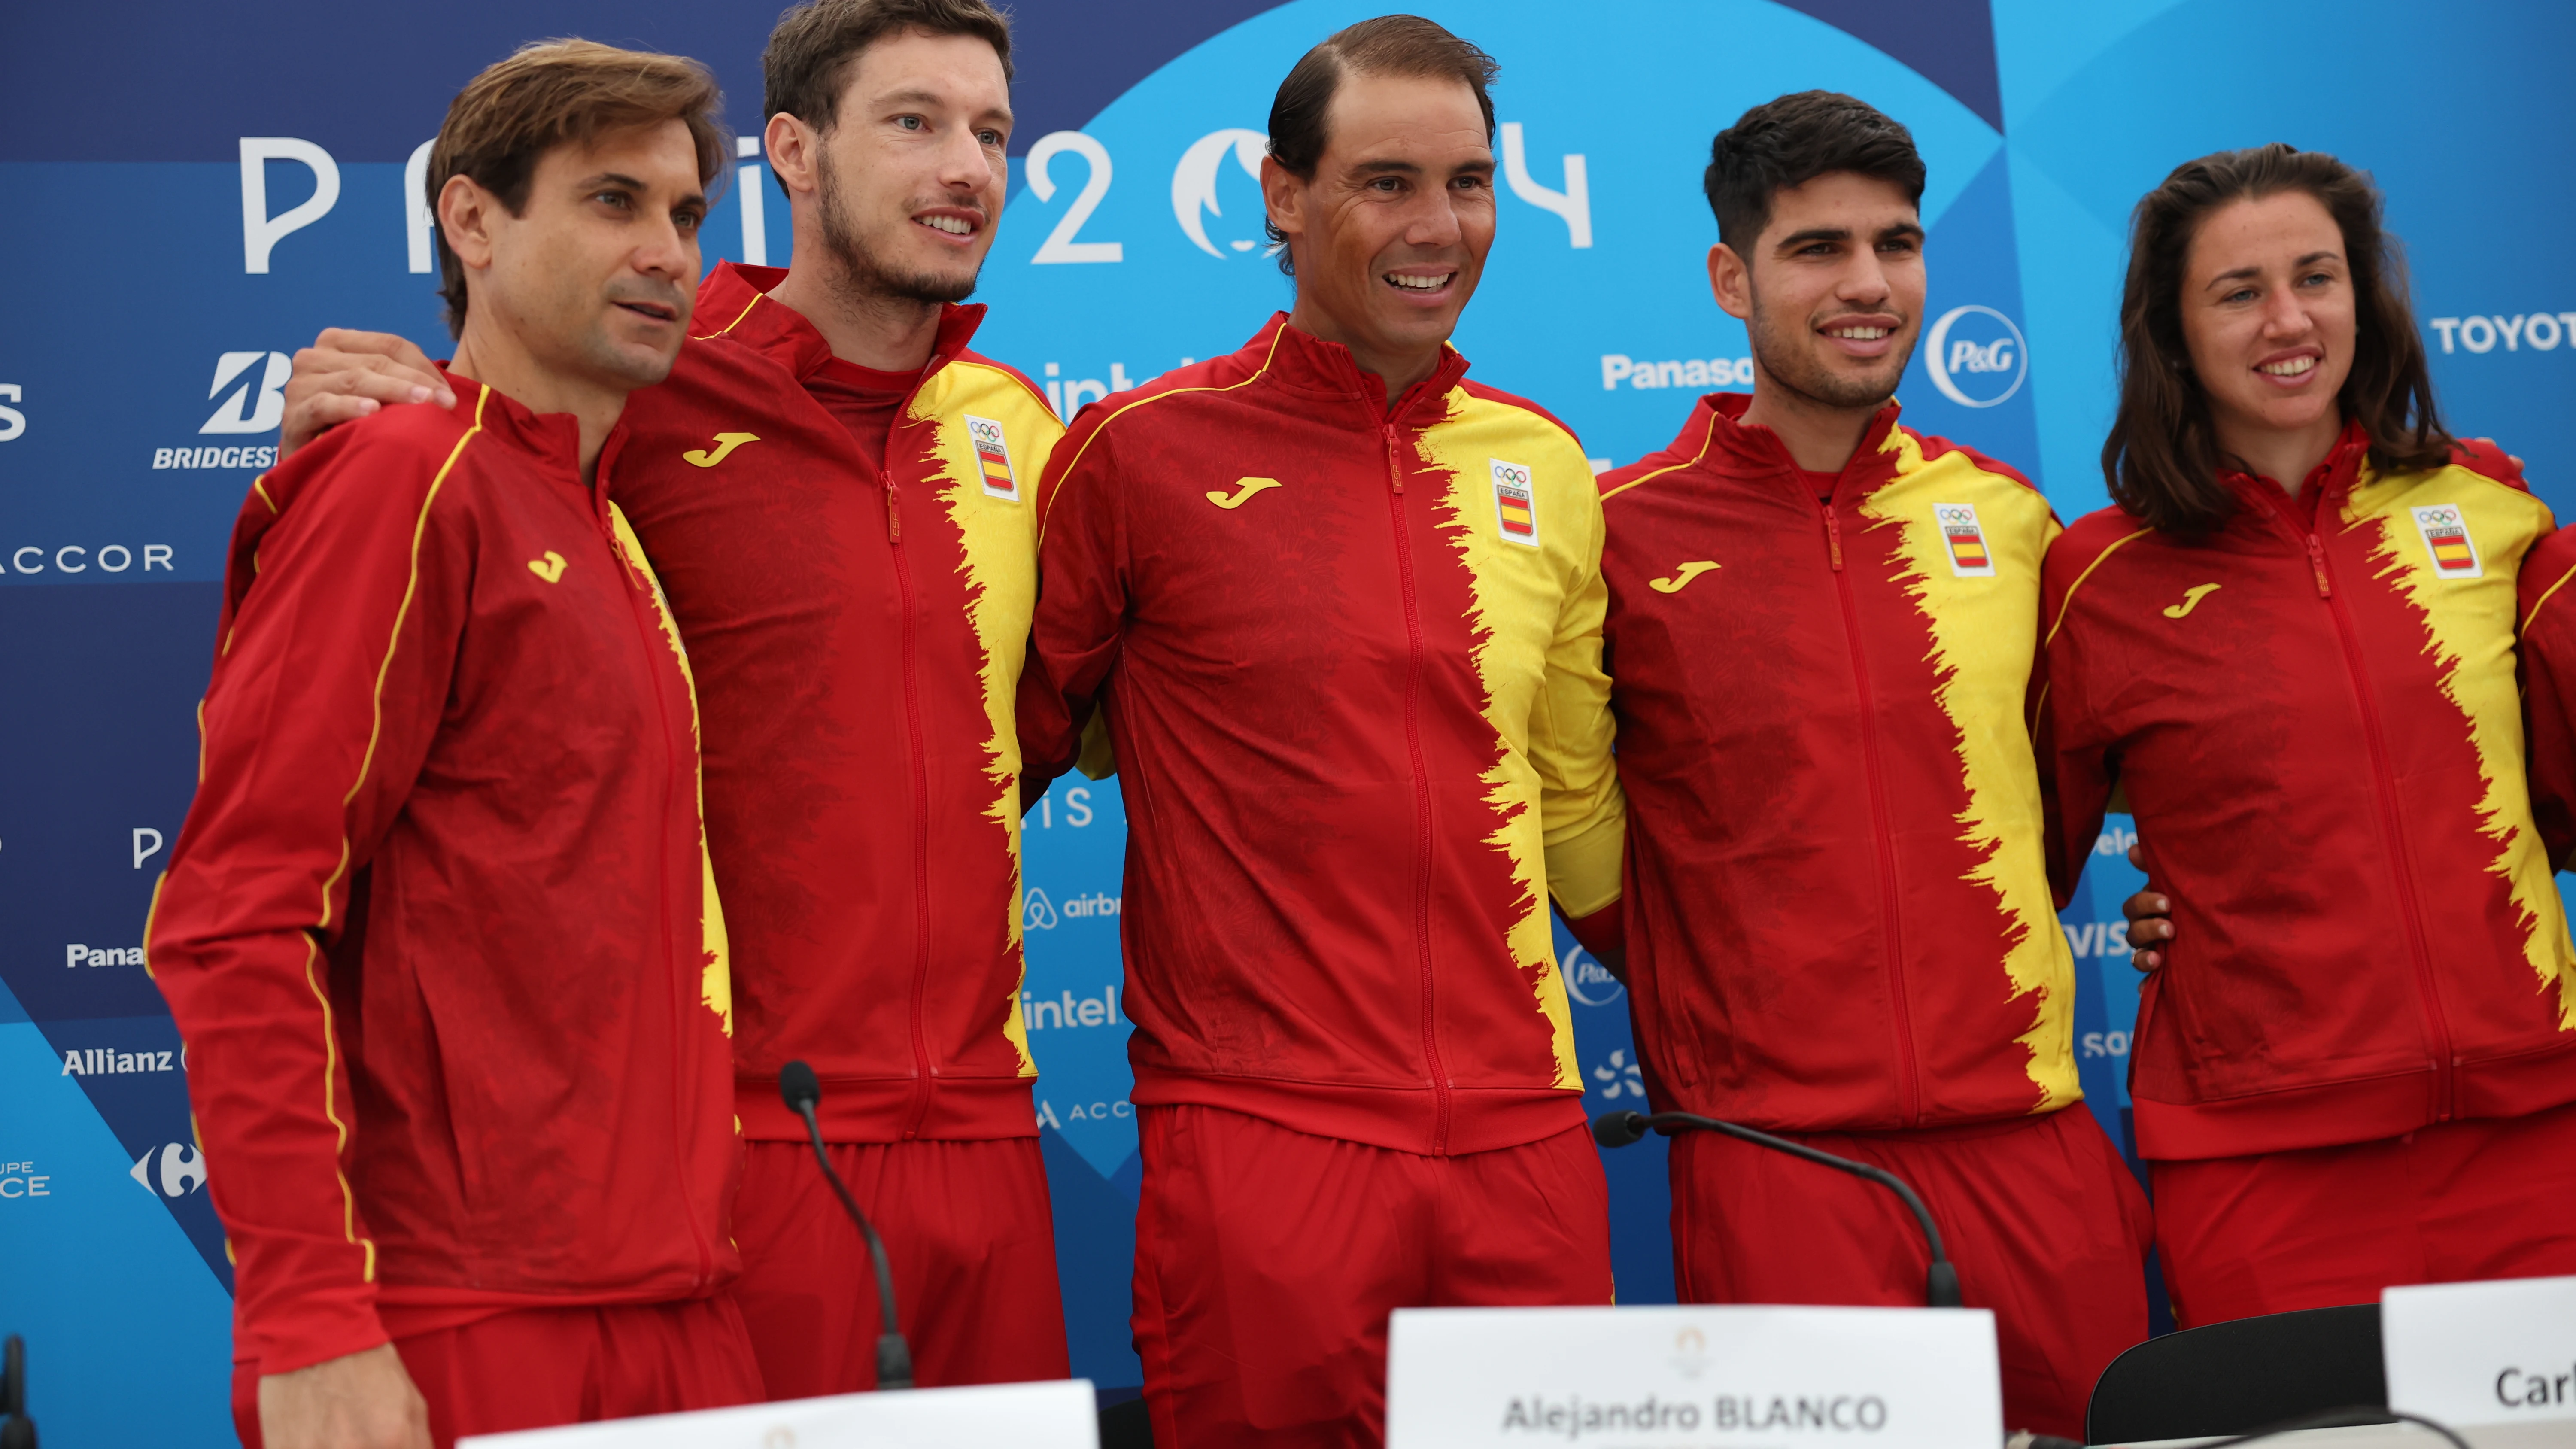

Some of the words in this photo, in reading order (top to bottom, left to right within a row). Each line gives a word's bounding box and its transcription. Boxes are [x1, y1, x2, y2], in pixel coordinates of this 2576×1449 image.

[1949, 337, 2015, 374] P&G
[979, 443, 1002, 453] ESPAÑA
[1500, 488, 1526, 498] ESPAÑA
[1023, 985, 1117, 1030] intel
[62, 1048, 173, 1076] Allianz
[1503, 1397, 1701, 1439] Alejandro
[1716, 1396, 1887, 1431] BLANCO
